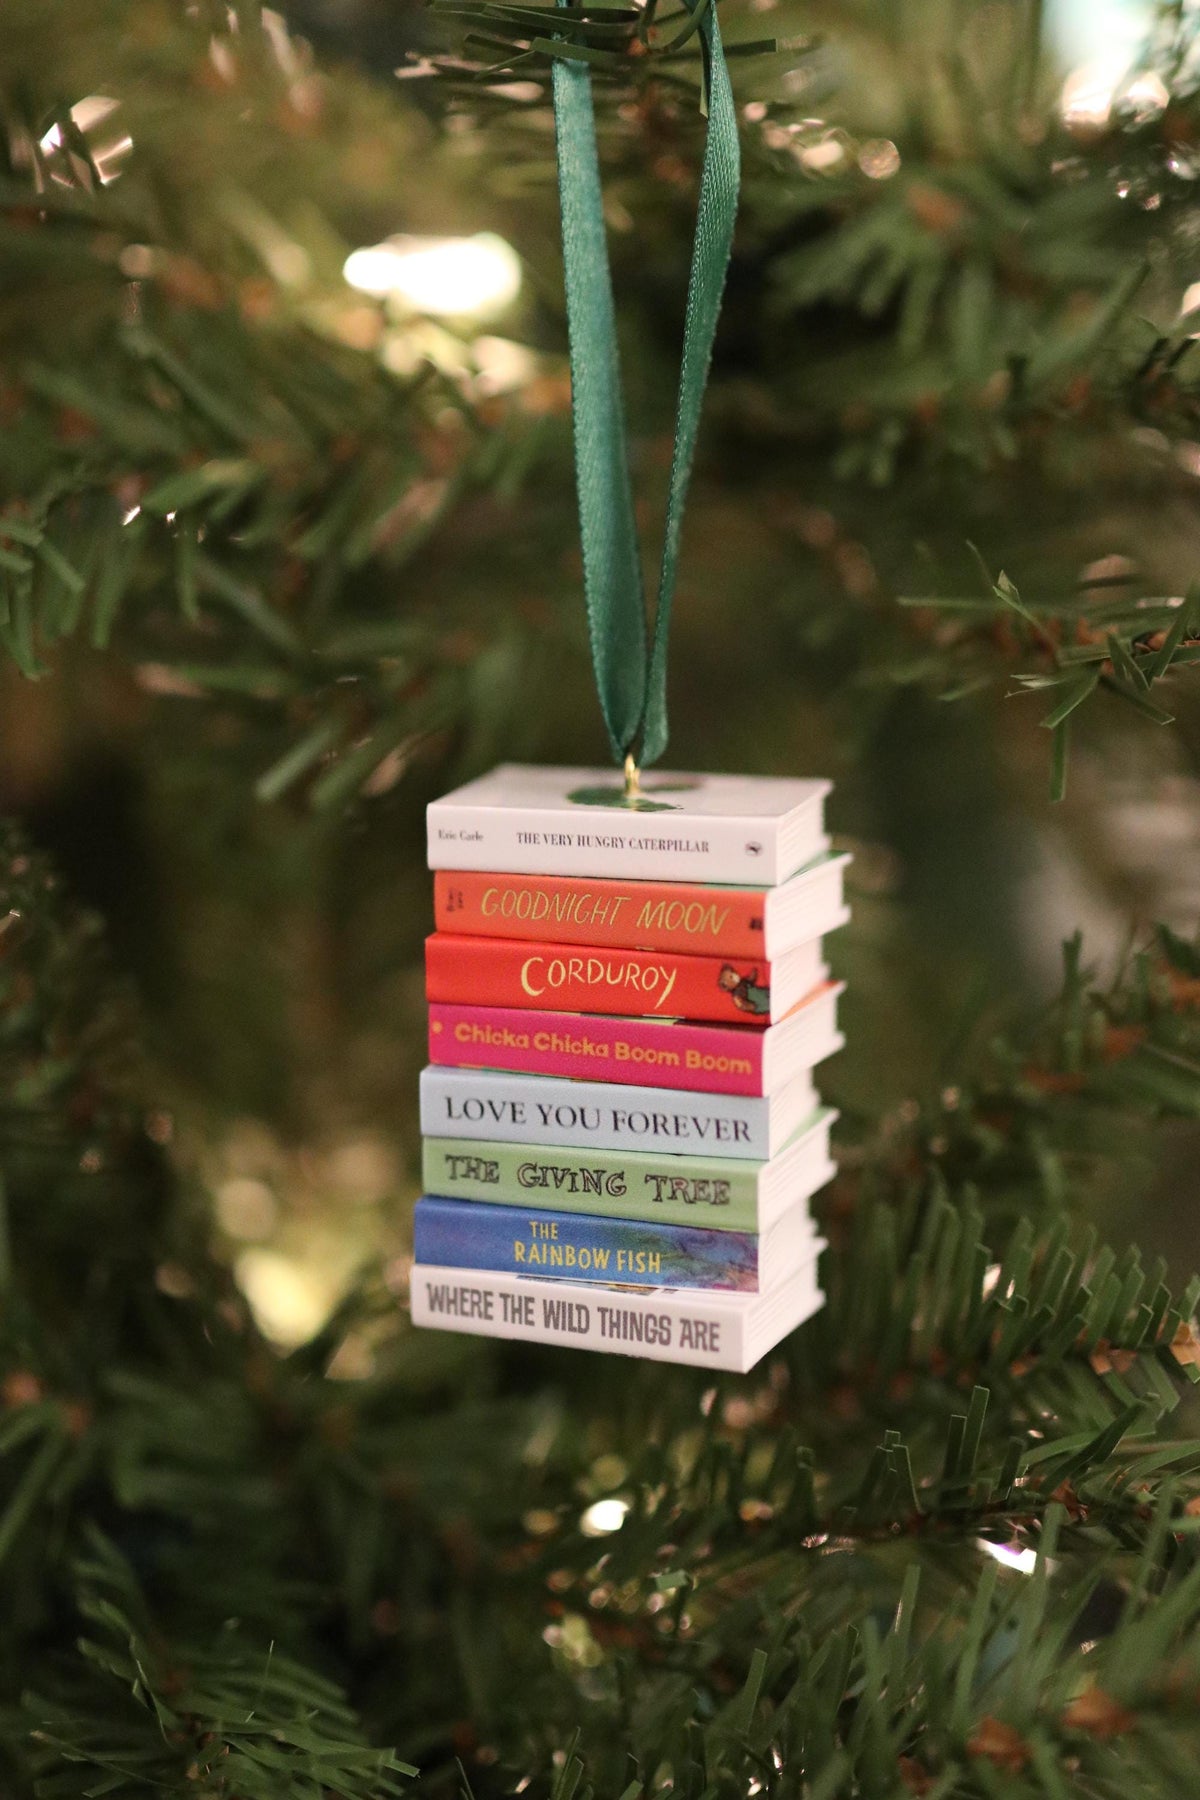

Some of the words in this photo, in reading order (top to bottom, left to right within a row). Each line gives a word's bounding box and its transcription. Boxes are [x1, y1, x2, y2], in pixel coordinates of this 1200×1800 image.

[517, 832, 540, 844] THE
[543, 833, 574, 847] VERY
[576, 835, 626, 849] HUNGRY
[629, 838, 709, 852] CATERPILLAR
[481, 888, 630, 927] GOODNIGHT
[636, 900, 730, 935] MOON
[520, 956, 677, 1009] CORDUROY
[455, 1022, 529, 1050] Chicka
[534, 1032, 608, 1057] Chicka
[615, 1042, 680, 1066] Boom
[686, 1050, 751, 1074] Boom
[445, 1097, 526, 1125] LOVE
[538, 1105, 600, 1131] YOU
[612, 1110, 751, 1141] FOREVER
[445, 1154, 499, 1183] THE
[517, 1163, 627, 1197] GIVING
[645, 1173, 730, 1206] TREE
[530, 1221, 558, 1240] THE
[514, 1240, 610, 1271] RAINBOW
[617, 1249, 661, 1273] FISH
[427, 1283, 494, 1320] WHERE
[500, 1293, 535, 1326] THE
[543, 1296, 590, 1334] WILD
[597, 1306, 671, 1345] THINGS
[680, 1318, 720, 1352] ARE
